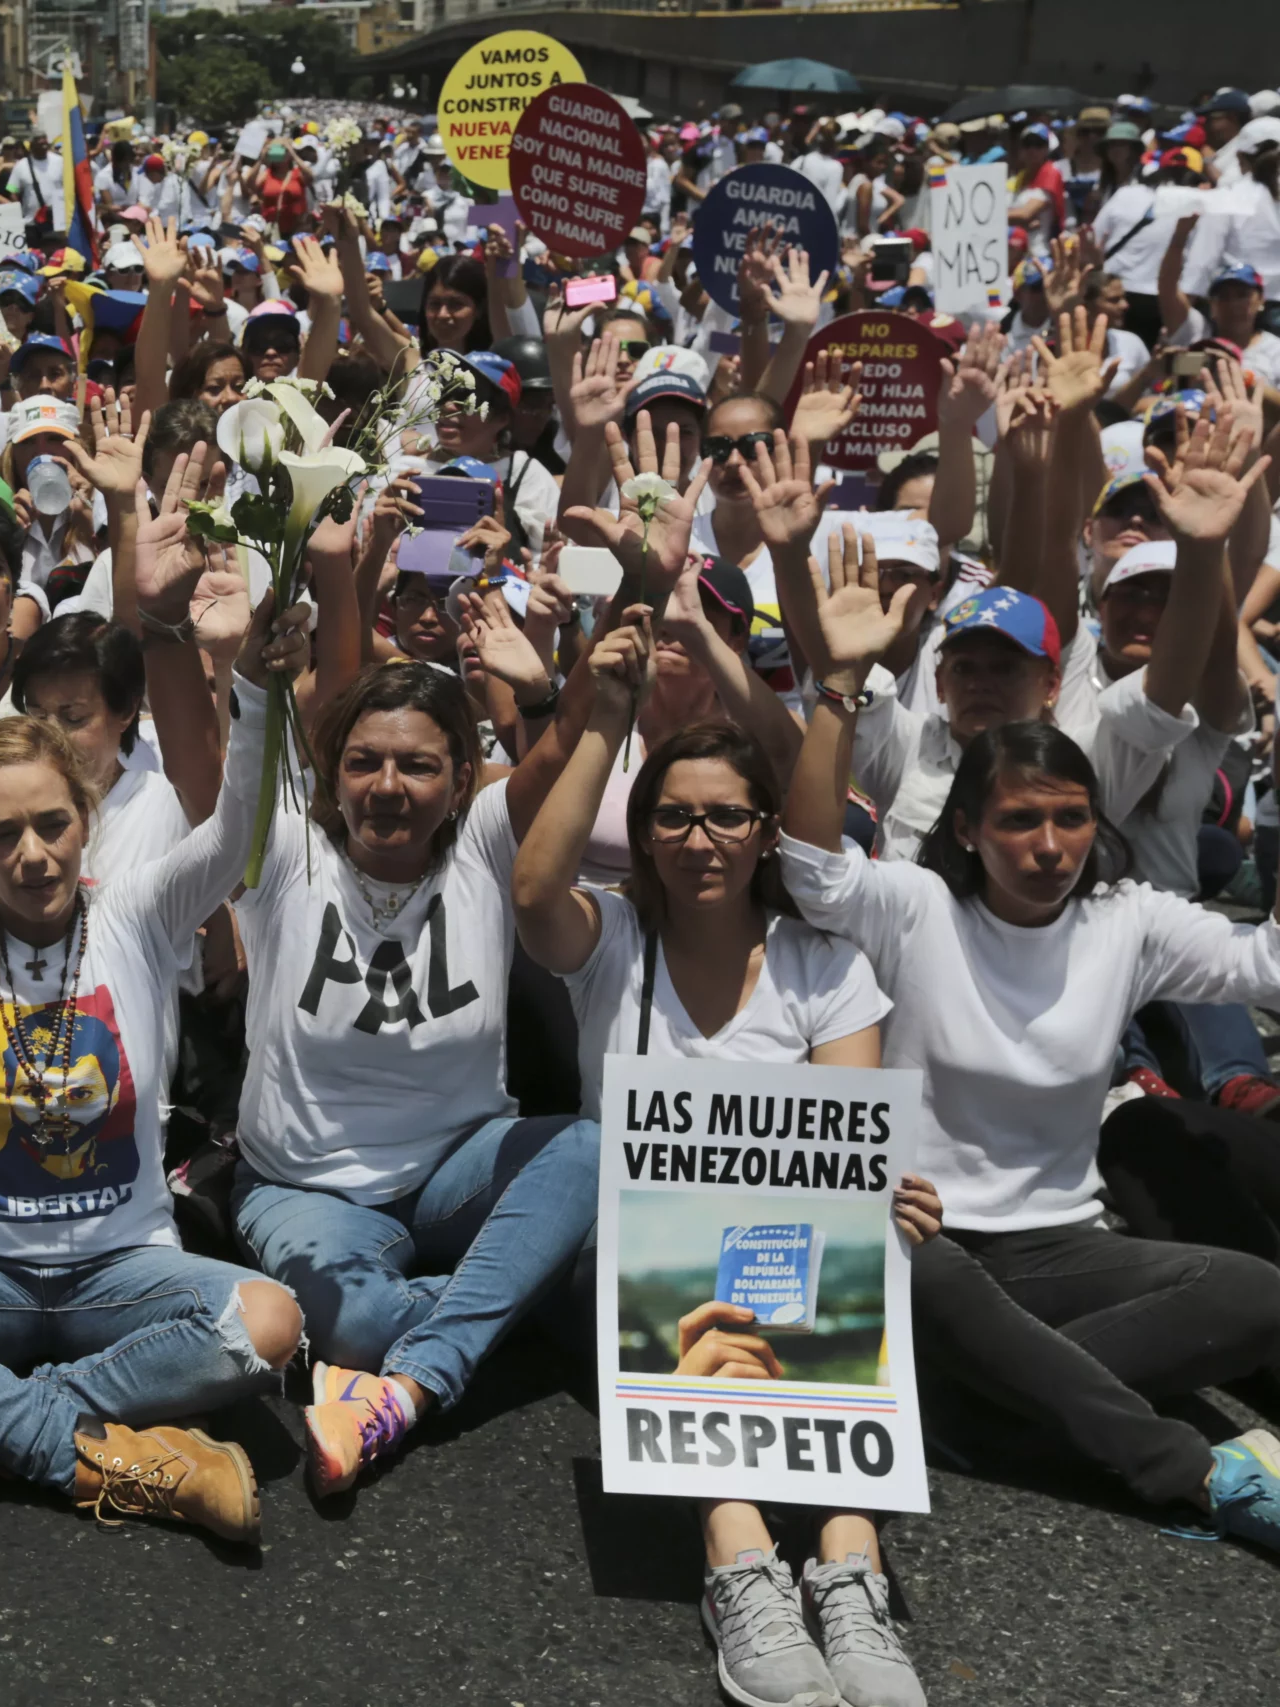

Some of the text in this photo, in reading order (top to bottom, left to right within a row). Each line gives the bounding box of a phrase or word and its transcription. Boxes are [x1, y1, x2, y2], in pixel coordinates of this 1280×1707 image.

[480, 47, 549, 65] VAMOS
[465, 70, 562, 89] JUNTOS A
[549, 95, 620, 131] GUARDIA
[450, 121, 511, 137] NUEVA
[539, 117, 623, 156] NACIONAL
[513, 133, 647, 188] SOY UNA MADRE
[532, 165, 620, 205] QUE SUFRE
[726, 180, 816, 211] GUARDIA
[520, 184, 624, 231] COMO SUFRE
[944, 180, 996, 230] NO
[531, 211, 606, 249] TU MAMA
[733, 207, 801, 235] AMIGA
[937, 238, 1000, 289] MAS
[861, 324, 890, 338] NO
[827, 343, 918, 359] DISPARES
[841, 363, 902, 378] PEDO
[882, 384, 925, 398] HIJA
[626, 1089, 891, 1145] LAS MUJERES
[623, 1142, 888, 1193] VENEZOLANAS
[742, 1263, 797, 1277] REPÚBLICA
[756, 1252, 785, 1264] DE LA
[731, 1291, 803, 1304] DE VENEZUELA
[734, 1278, 802, 1290] BOLIVARIANA
[626, 1407, 895, 1478] RESPETO
